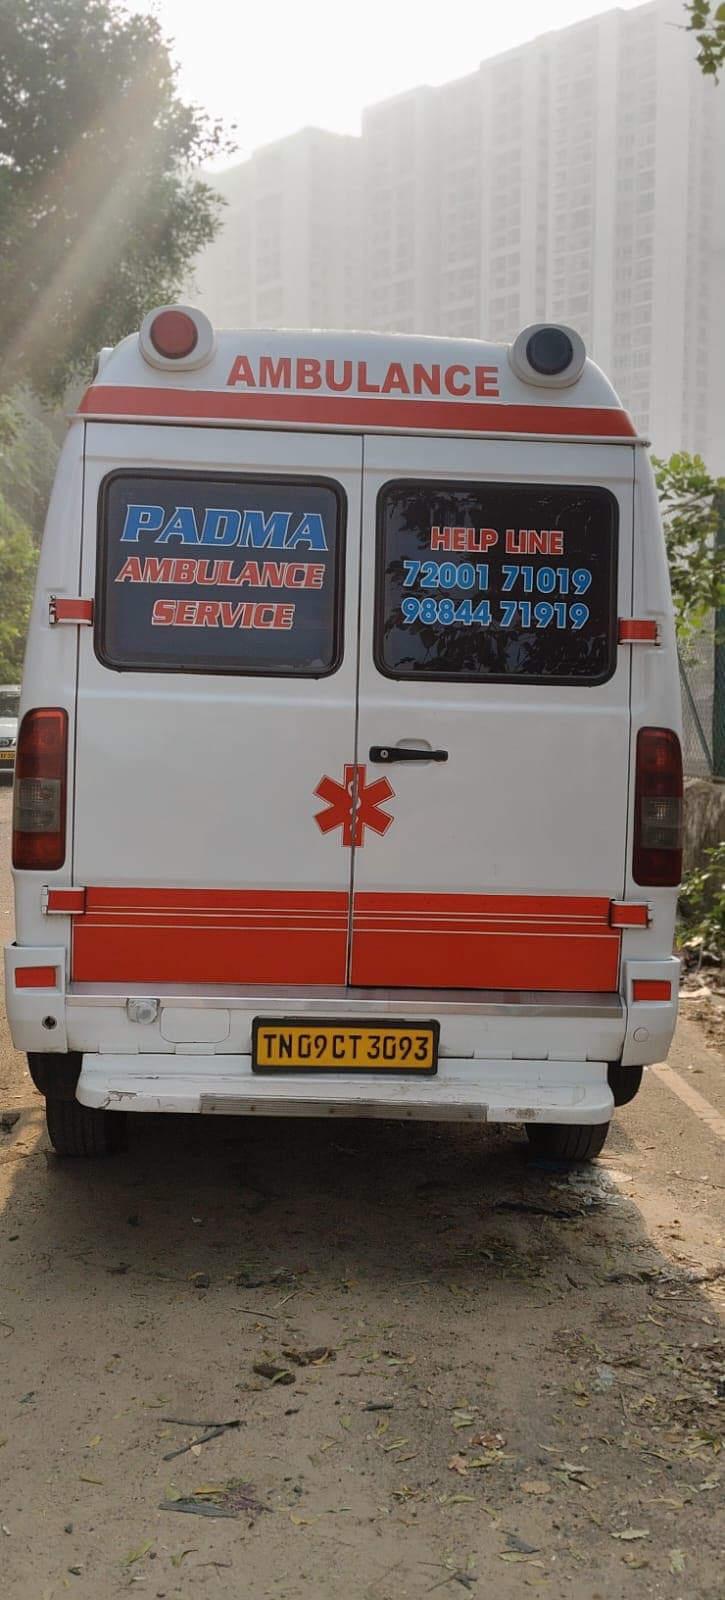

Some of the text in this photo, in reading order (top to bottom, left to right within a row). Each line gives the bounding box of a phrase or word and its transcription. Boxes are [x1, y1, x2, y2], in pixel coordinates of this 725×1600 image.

[227, 356, 499, 397] AMBULANCE
[120, 505, 328, 550] PADMA
[431, 526, 564, 555] HELP LINE
[115, 556, 325, 589] AMBULANCE
[403, 561, 592, 595] 72001 71019
[152, 599, 295, 630] SERVICE
[401, 597, 589, 630] 98844 71919
